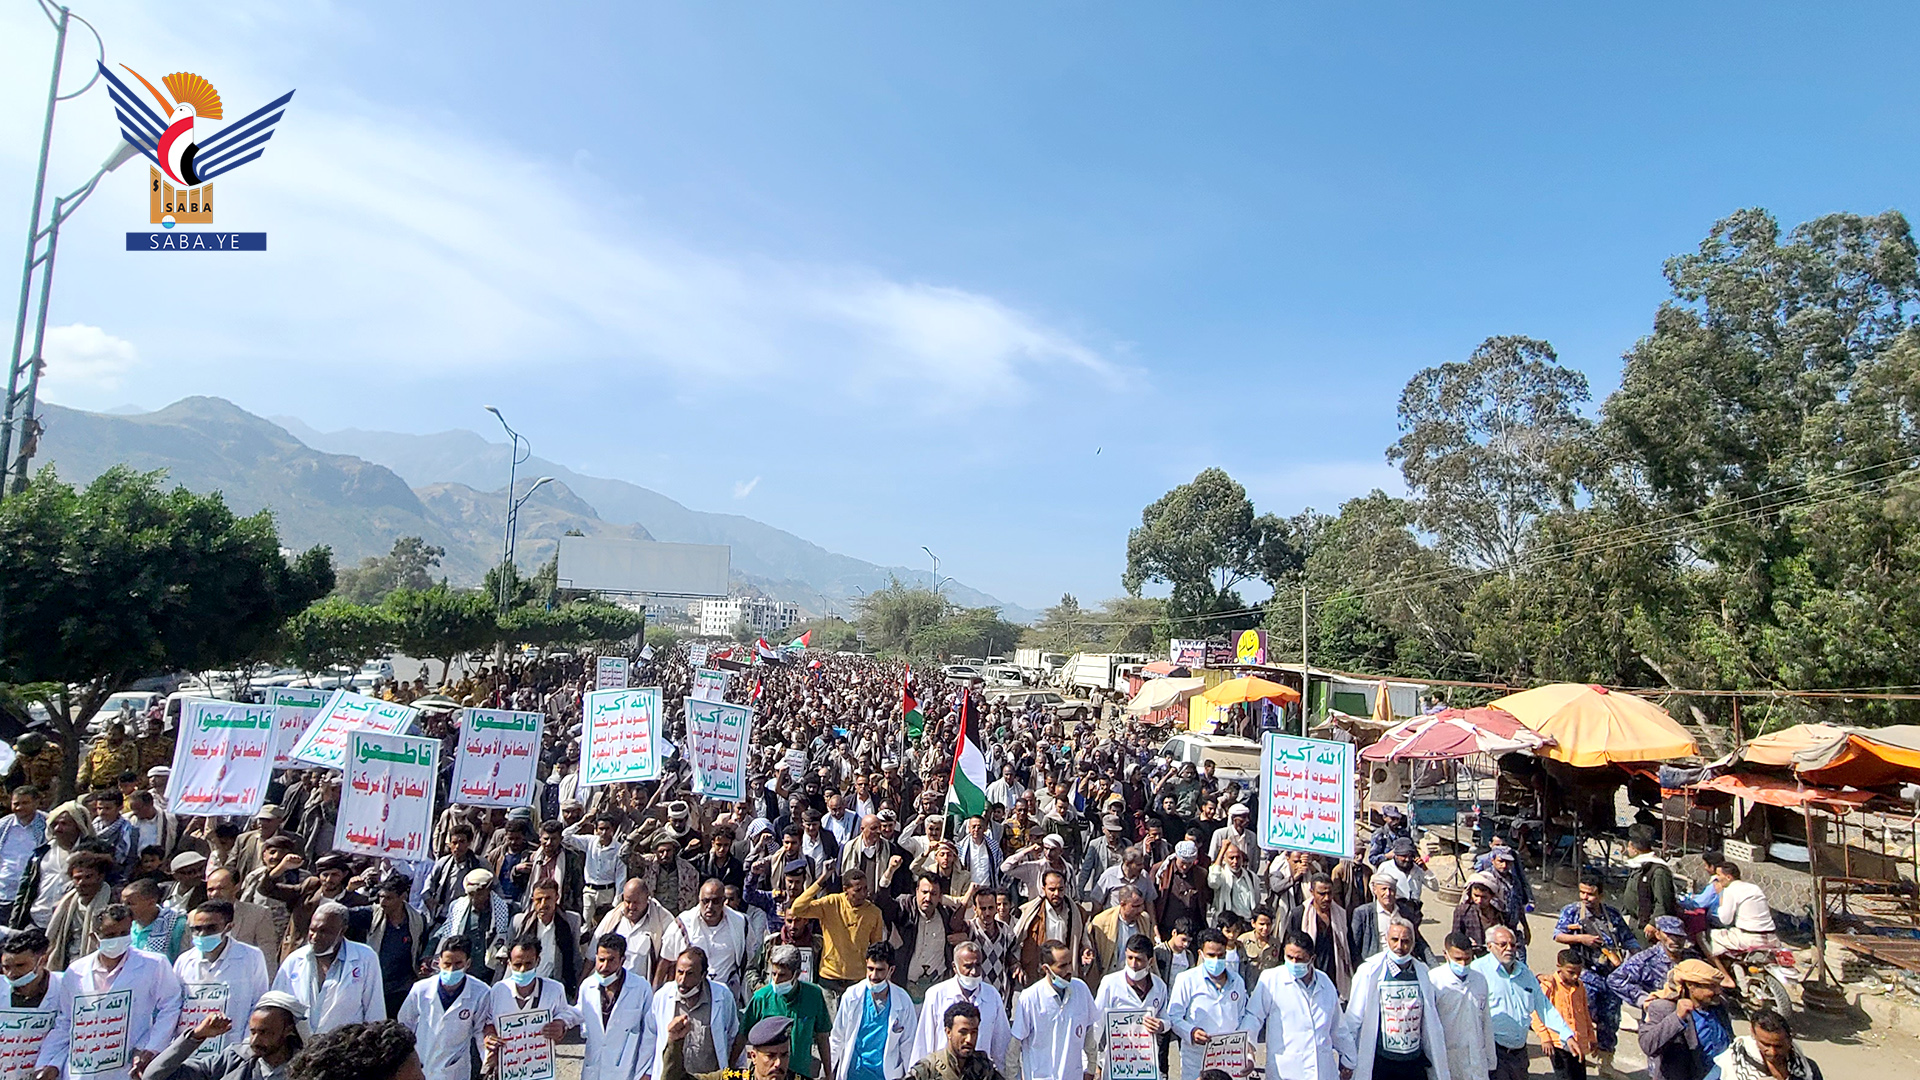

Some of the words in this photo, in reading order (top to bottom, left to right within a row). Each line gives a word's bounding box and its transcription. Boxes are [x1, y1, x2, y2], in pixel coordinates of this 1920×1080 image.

[339, 699, 382, 712] أكبر
[595, 694, 629, 716] أكبر
[630, 694, 651, 708] الله
[198, 707, 274, 732] قاطعوا
[378, 705, 405, 719] الله
[723, 712, 743, 727] الله
[471, 710, 537, 732] قاطعوا
[594, 713, 624, 729] لأمريكا
[593, 730, 624, 745] لإسرائيل
[719, 732, 740, 743] الموت
[191, 738, 229, 760] الأمريكية
[231, 739, 267, 761] البضائع
[355, 736, 431, 766] قاطعوا
[466, 737, 502, 757] الأمريكية
[502, 740, 534, 760] البضائع
[592, 747, 614, 759] اليهود
[616, 745, 628, 757] على
[717, 748, 738, 758] الموت
[1275, 742, 1315, 764] أكبر
[1316, 747, 1341, 765] الله
[218, 764, 227, 782] و
[492, 762, 500, 777] و
[590, 760, 621, 778] للإسلام
[624, 757, 650, 775] النصر
[1274, 764, 1310, 781] لأمريكا
[352, 770, 392, 796] الأمريكية
[713, 775, 735, 791] النصر
[1312, 772, 1340, 785] الموت
[392, 776, 429, 802] البضائع
[461, 779, 527, 802] الإسرائيلية
[1273, 784, 1309, 803] لإسرائيل
[181, 786, 256, 809] الإسرائيلية
[1311, 791, 1340, 804] الموت
[381, 803, 390, 823] و
[1272, 804, 1297, 819] اليهود
[1300, 807, 1314, 821] على
[1318, 808, 1340, 823] اللعنة
[346, 823, 422, 856] الإسرائيلية
[1271, 821, 1306, 844] للإسلام
[1309, 826, 1340, 845] النصر
[208, 987, 227, 999] الله
[1385, 988, 1405, 1003] أكبر
[76, 997, 106, 1017] أكبر
[105, 995, 128, 1009] الله
[31, 1017, 53, 1029] الله
[101, 1012, 127, 1025] الموت
[503, 1015, 529, 1033] أكبر
[531, 1014, 548, 1025] الله
[1111, 1013, 1134, 1029] أكبر
[99, 1026, 125, 1038] الموت
[1230, 1036, 1244, 1044] الله
[1209, 1036, 1230, 1050] أكبر
[94, 1051, 122, 1069] النصر
[504, 1066, 528, 1080] للإسلام
[530, 1061, 550, 1077] النصر
[1112, 1064, 1133, 1078] للإسلام
[1136, 1063, 1154, 1077] النصر
